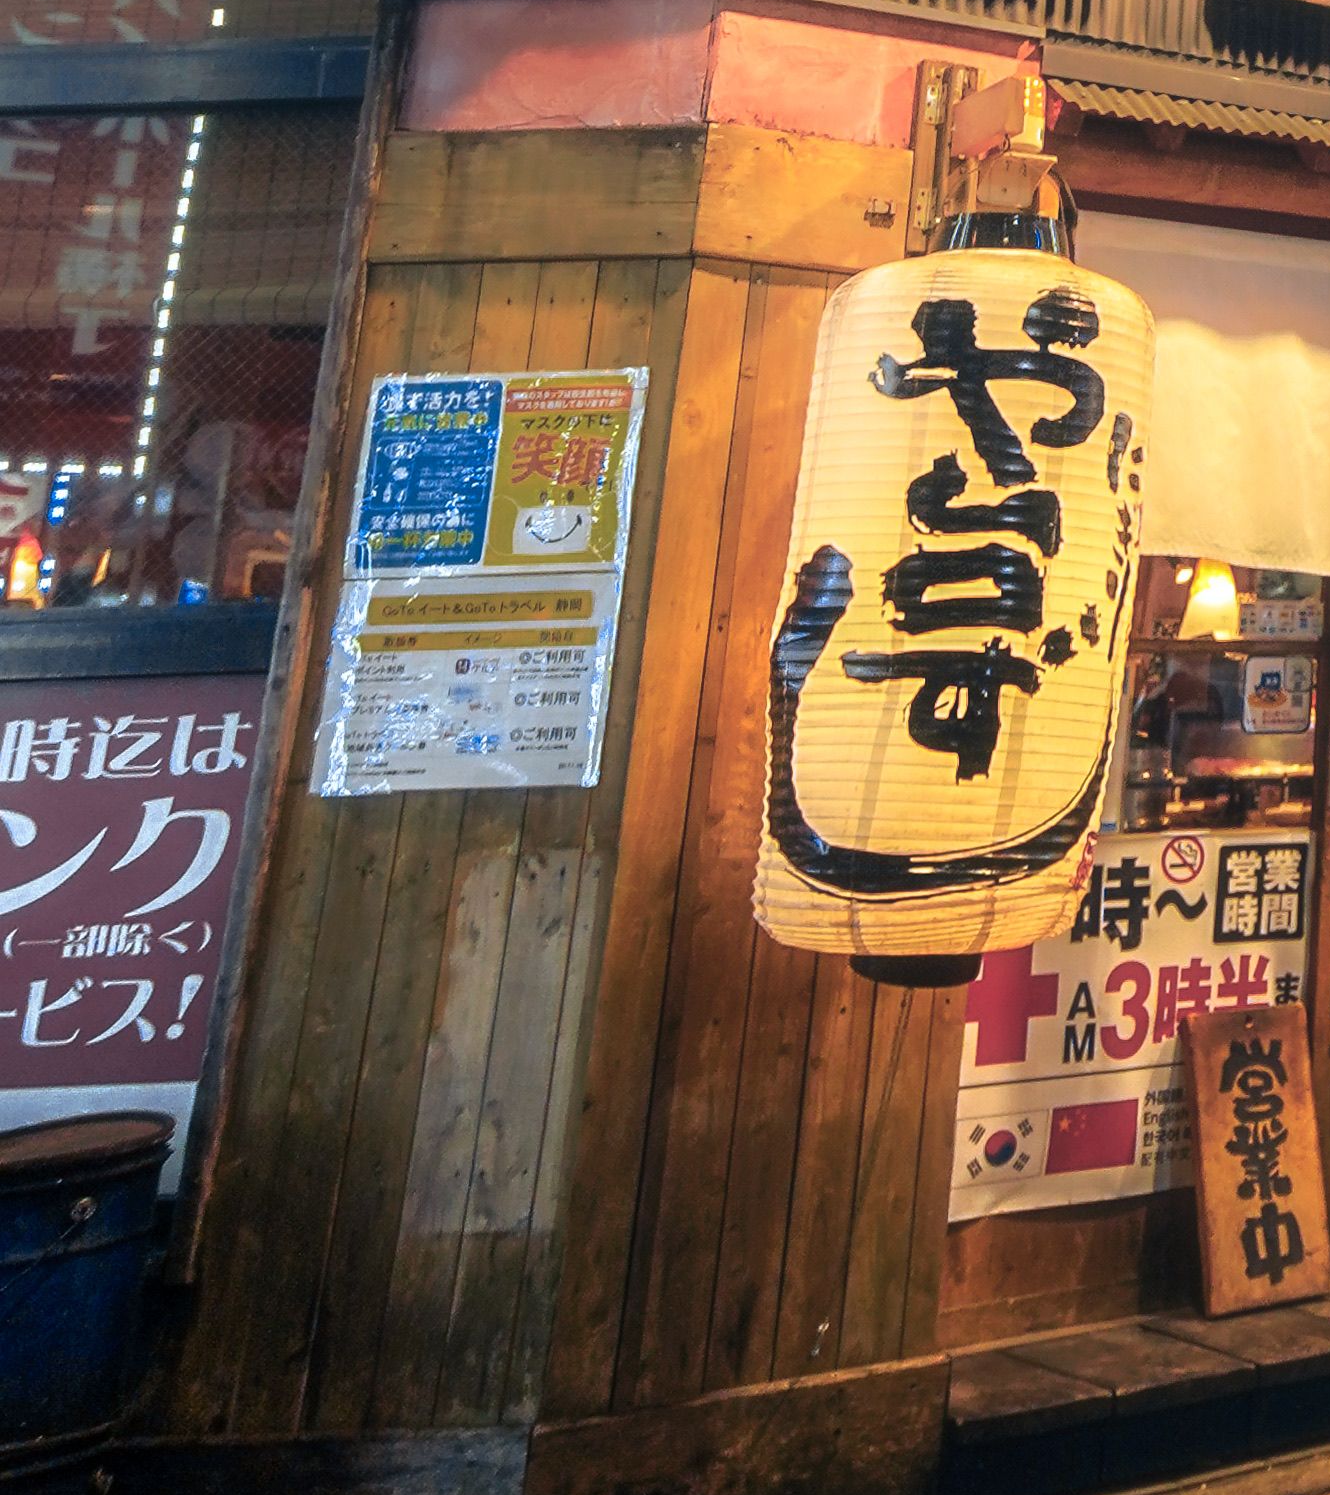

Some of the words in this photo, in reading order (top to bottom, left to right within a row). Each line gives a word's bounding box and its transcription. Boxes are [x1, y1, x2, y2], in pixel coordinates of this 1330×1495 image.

[511, 431, 613, 487] 笑顔
[1, 920, 214, 960] (一部除く)
[1219, 1038, 1304, 1287] 営業中
